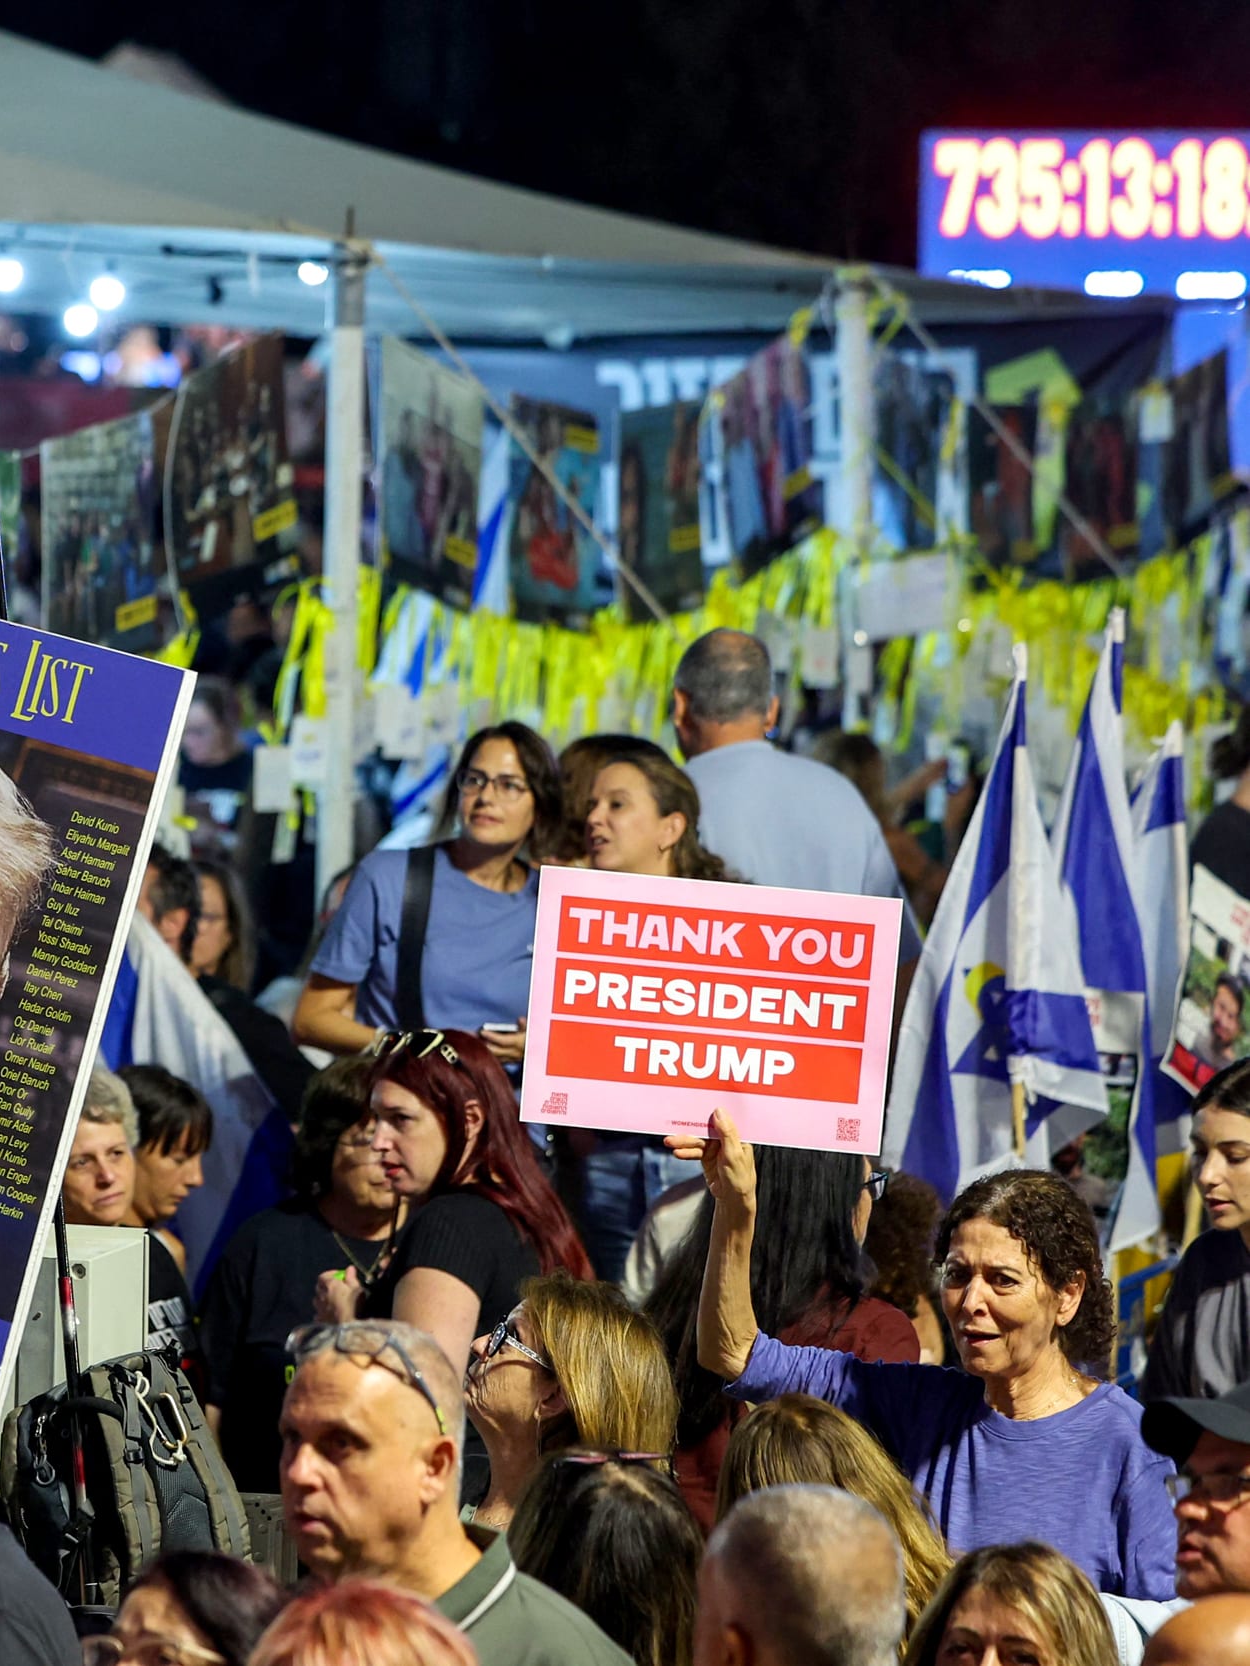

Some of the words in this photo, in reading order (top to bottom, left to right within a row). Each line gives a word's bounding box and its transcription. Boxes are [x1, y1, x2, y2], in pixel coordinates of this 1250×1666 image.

[933, 137, 1250, 239] 735:13:18
[10, 639, 94, 725] LIST
[70, 811, 95, 827] David
[95, 818, 120, 834] Kunio
[66, 829, 95, 846] Eliyahu
[96, 837, 130, 856] Margalit
[60, 847, 81, 859] Asaf
[80, 852, 116, 871] Hamami
[56, 863, 81, 879] Sahar
[81, 871, 110, 888] Baruch
[51, 880, 72, 895] Inbar
[74, 888, 106, 905] Haiman
[46, 898, 65, 914] Guy
[41, 915, 54, 927] Tal
[54, 919, 84, 936] Chaimi
[568, 906, 746, 959] THANK
[759, 924, 866, 969] YOU
[38, 930, 59, 946] Yossi
[59, 937, 92, 956] Sharabi
[32, 947, 61, 966] Manny
[61, 956, 97, 975] Goddard
[26, 963, 54, 980] Daniel
[53, 971, 78, 988] Perez
[23, 981, 39, 996] Itay
[40, 986, 62, 1002] Chen
[563, 968, 857, 1031] PRESIDENT
[18, 998, 45, 1015] Hadar
[45, 1006, 71, 1023] Goldin
[14, 1016, 27, 1028] Oz
[27, 1020, 54, 1036] Daniel
[9, 1033, 26, 1045] Lior
[4, 1050, 29, 1066] Omer
[614, 1035, 796, 1086] TRUMP
[0, 1066, 20, 1081] Oriel
[20, 1073, 50, 1091] Baruch
[17, 1088, 29, 1100] Or
[12, 1119, 34, 1134] Adar
[8, 1135, 30, 1152] Levy
[2, 1150, 27, 1166] Kunio
[6, 1168, 32, 1185] Engel
[6, 1186, 37, 1204] Cooper
